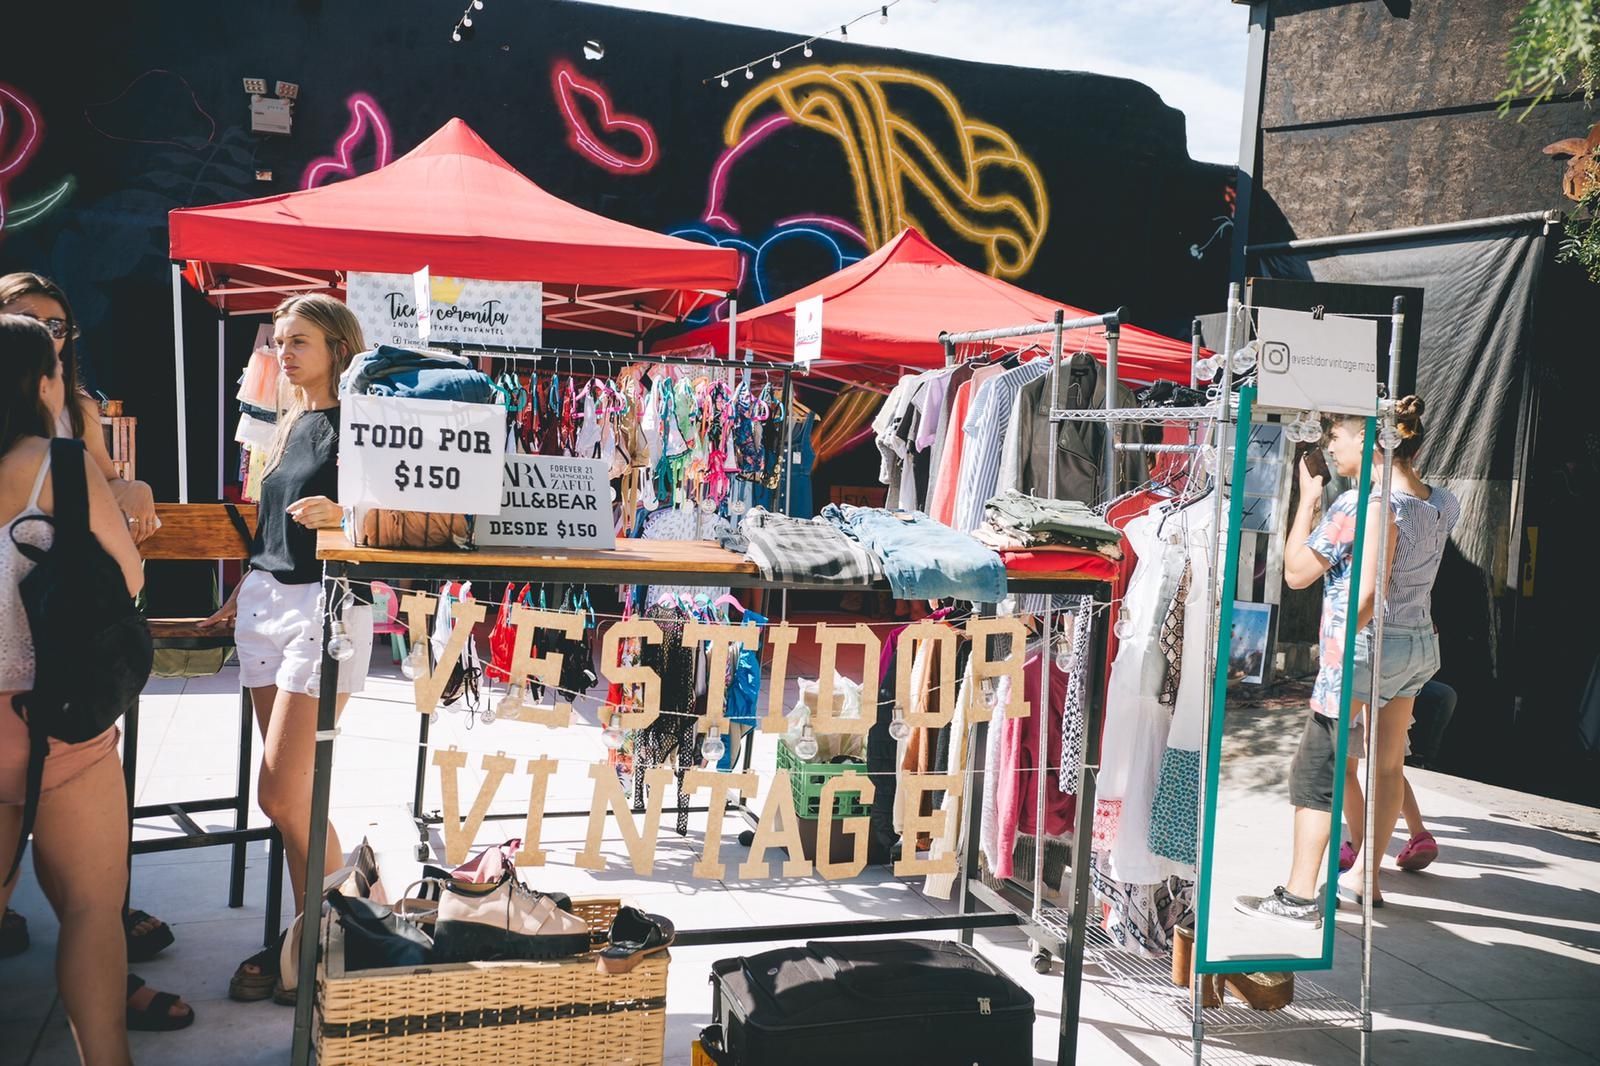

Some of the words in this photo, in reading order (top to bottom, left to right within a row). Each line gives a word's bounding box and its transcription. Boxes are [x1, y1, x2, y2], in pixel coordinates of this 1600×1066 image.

[436, 299, 509, 327] coronita
[350, 422, 423, 450] TODO
[439, 428, 492, 454] POR
[394, 460, 461, 492] $150
[502, 461, 547, 489] ARA
[550, 464, 582, 473] FOREVER
[585, 466, 593, 474] 21
[550, 479, 595, 492] ZAFUL
[501, 491, 597, 511] ULL&BEAR
[490, 521, 548, 536] DESDE
[557, 520, 597, 539] $150
[400, 591, 1031, 734] VESTIDOR
[432, 747, 965, 880] VINTAGE
